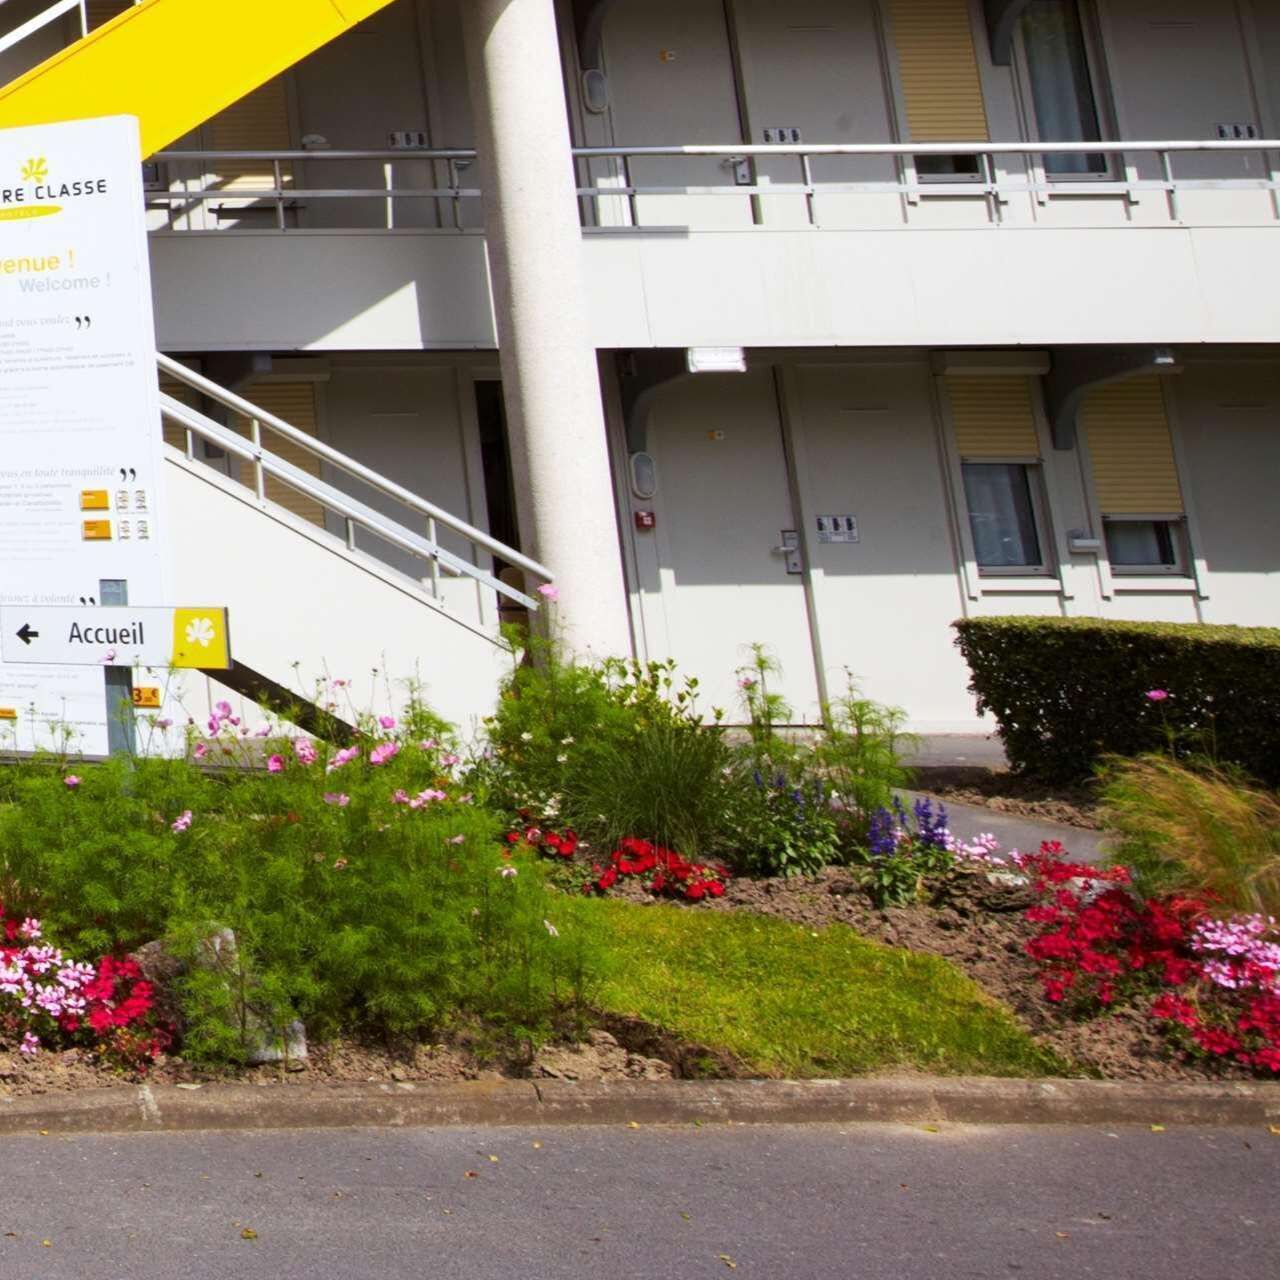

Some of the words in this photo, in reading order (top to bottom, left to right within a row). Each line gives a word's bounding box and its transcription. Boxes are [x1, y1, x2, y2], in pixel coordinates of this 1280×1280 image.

[35, 179, 107, 200] CLASSE
[18, 275, 101, 293] Welcome
[68, 620, 145, 646] Accueil
